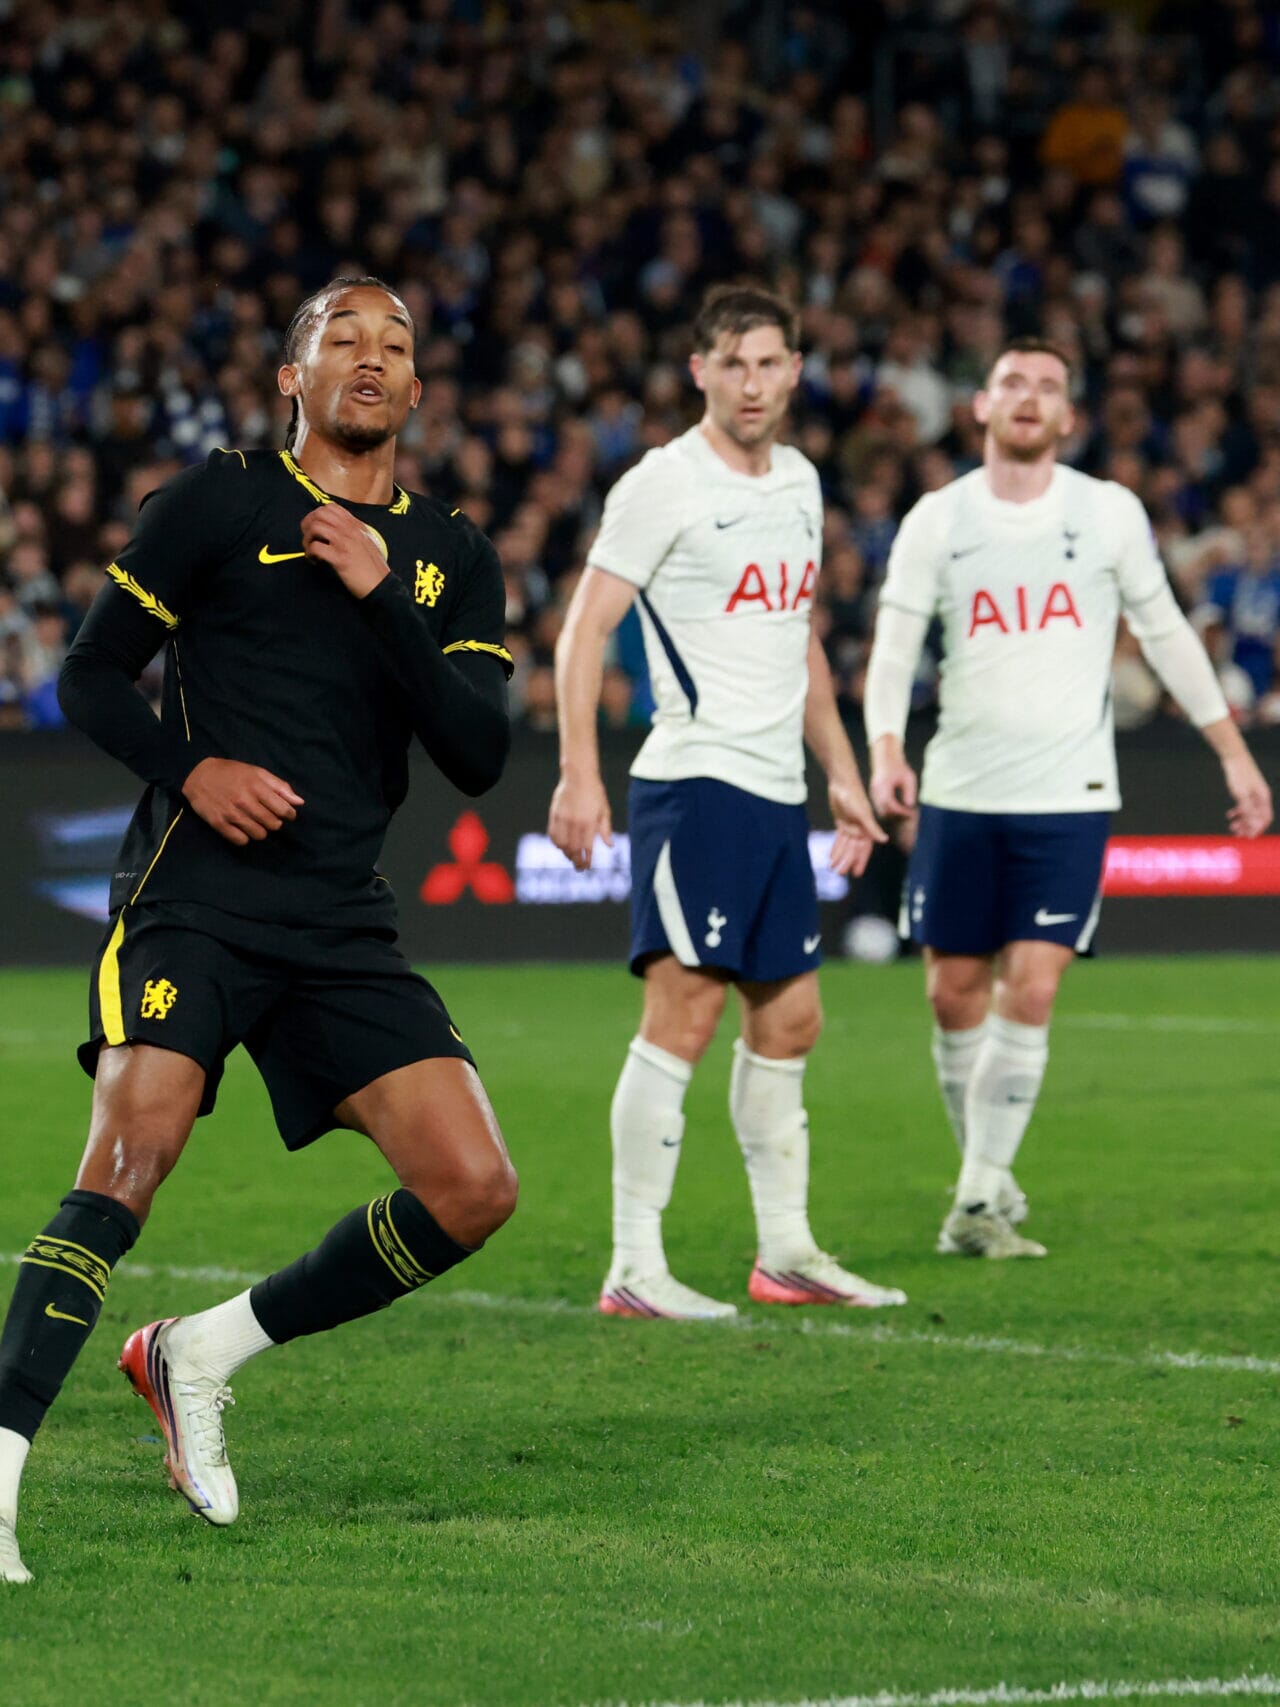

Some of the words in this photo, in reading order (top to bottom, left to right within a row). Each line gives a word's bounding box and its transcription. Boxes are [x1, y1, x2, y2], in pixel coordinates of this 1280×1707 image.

[724, 560, 816, 613] AIA
[967, 582, 1083, 638] AIA
[1106, 846, 1243, 884] TIONING
